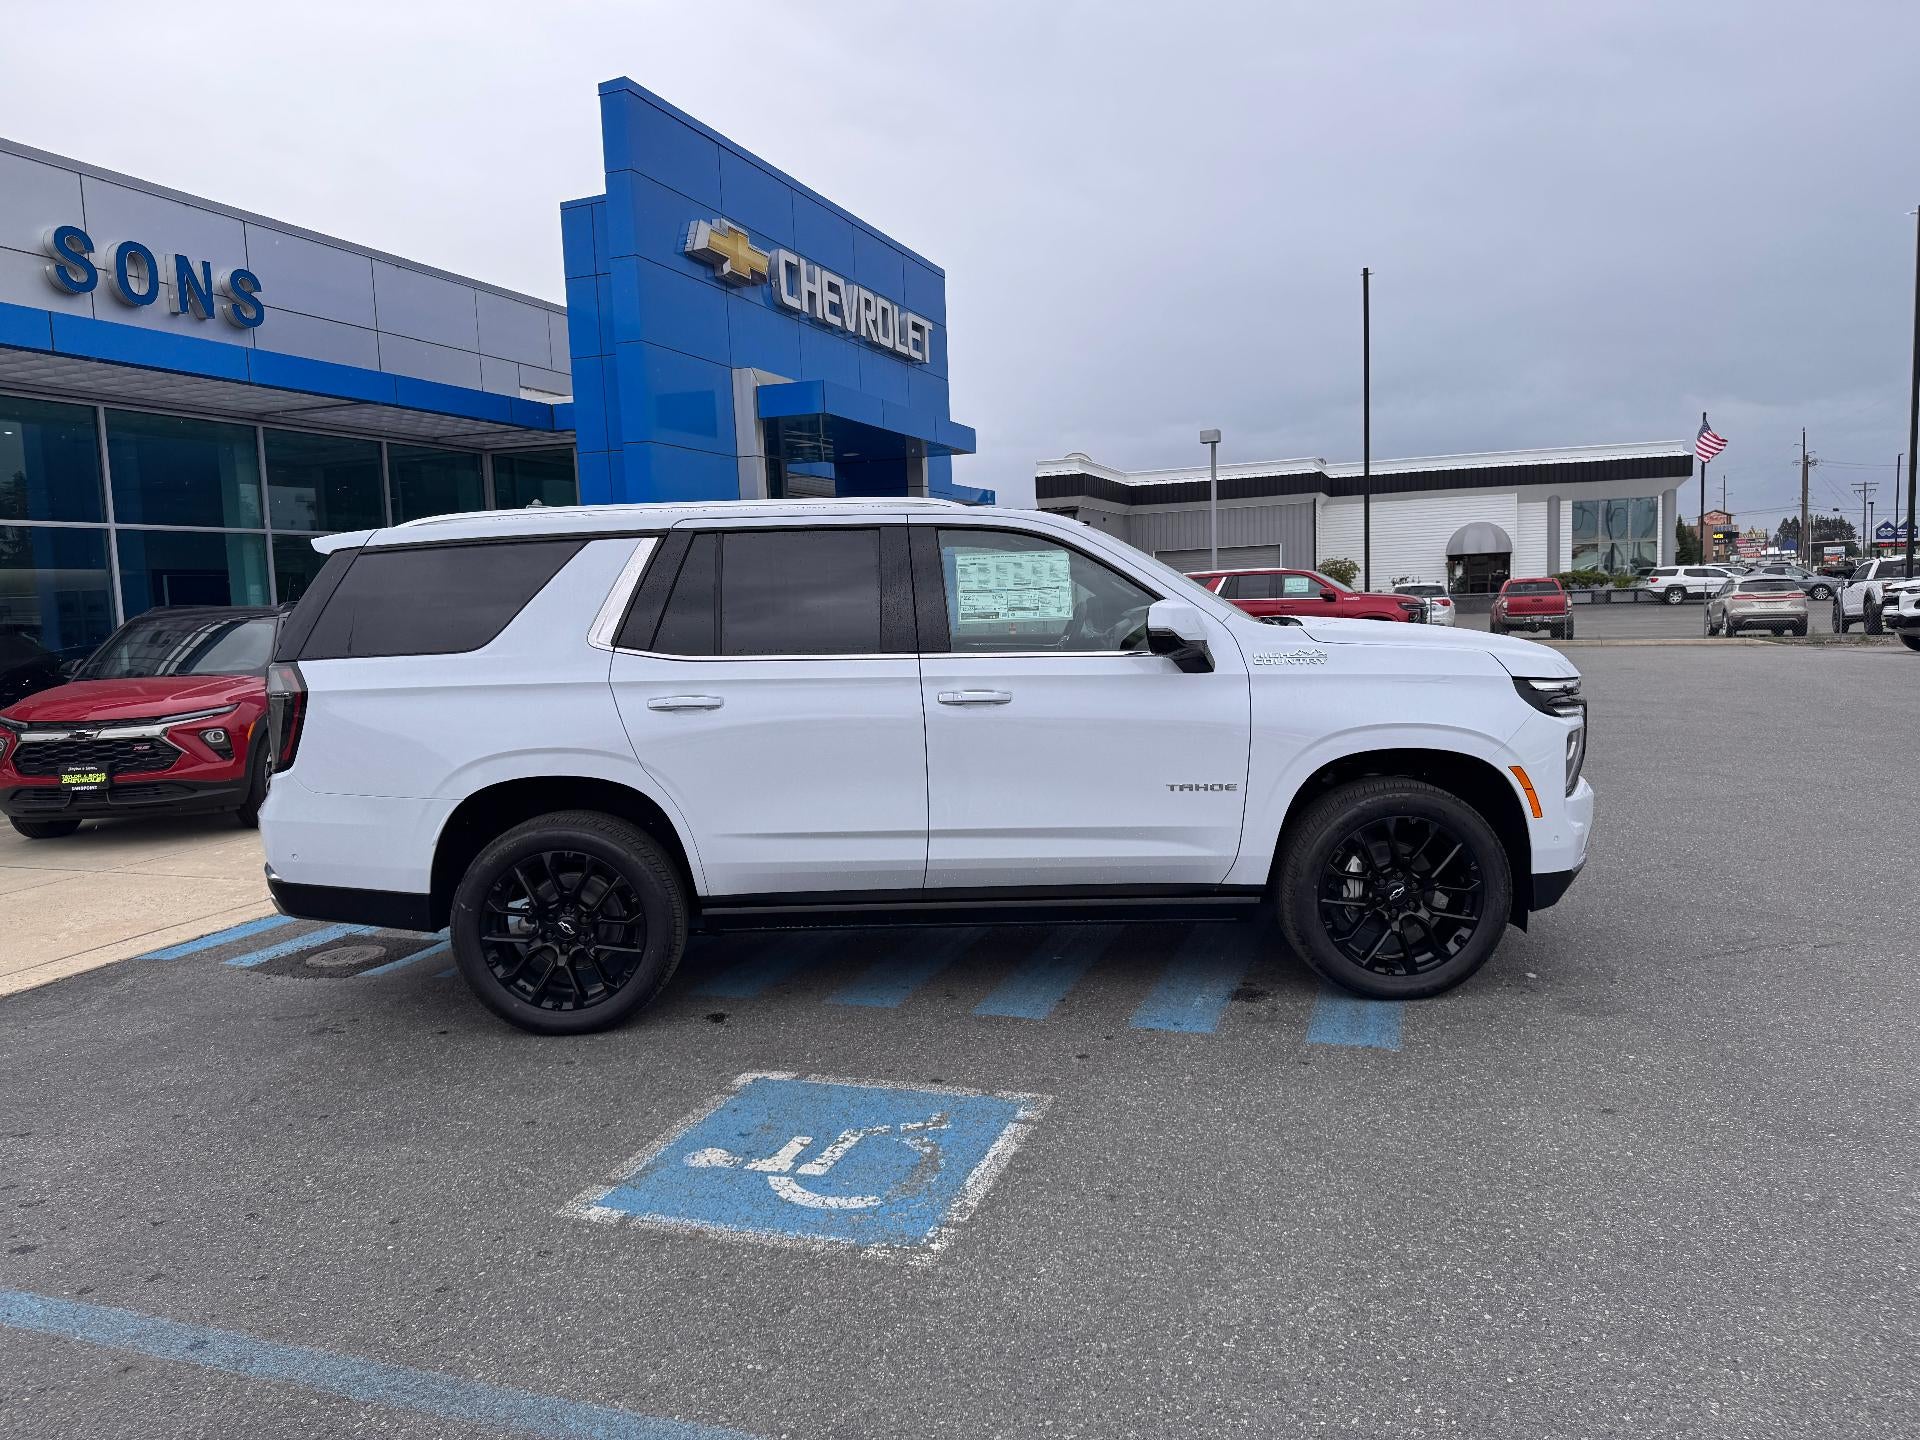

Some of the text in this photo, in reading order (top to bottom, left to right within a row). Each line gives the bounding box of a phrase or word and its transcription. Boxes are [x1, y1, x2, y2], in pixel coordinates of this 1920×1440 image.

[44, 225, 264, 329] SONS
[768, 248, 933, 364] CHEVROLET
[1165, 783, 1238, 791] TAHOE
